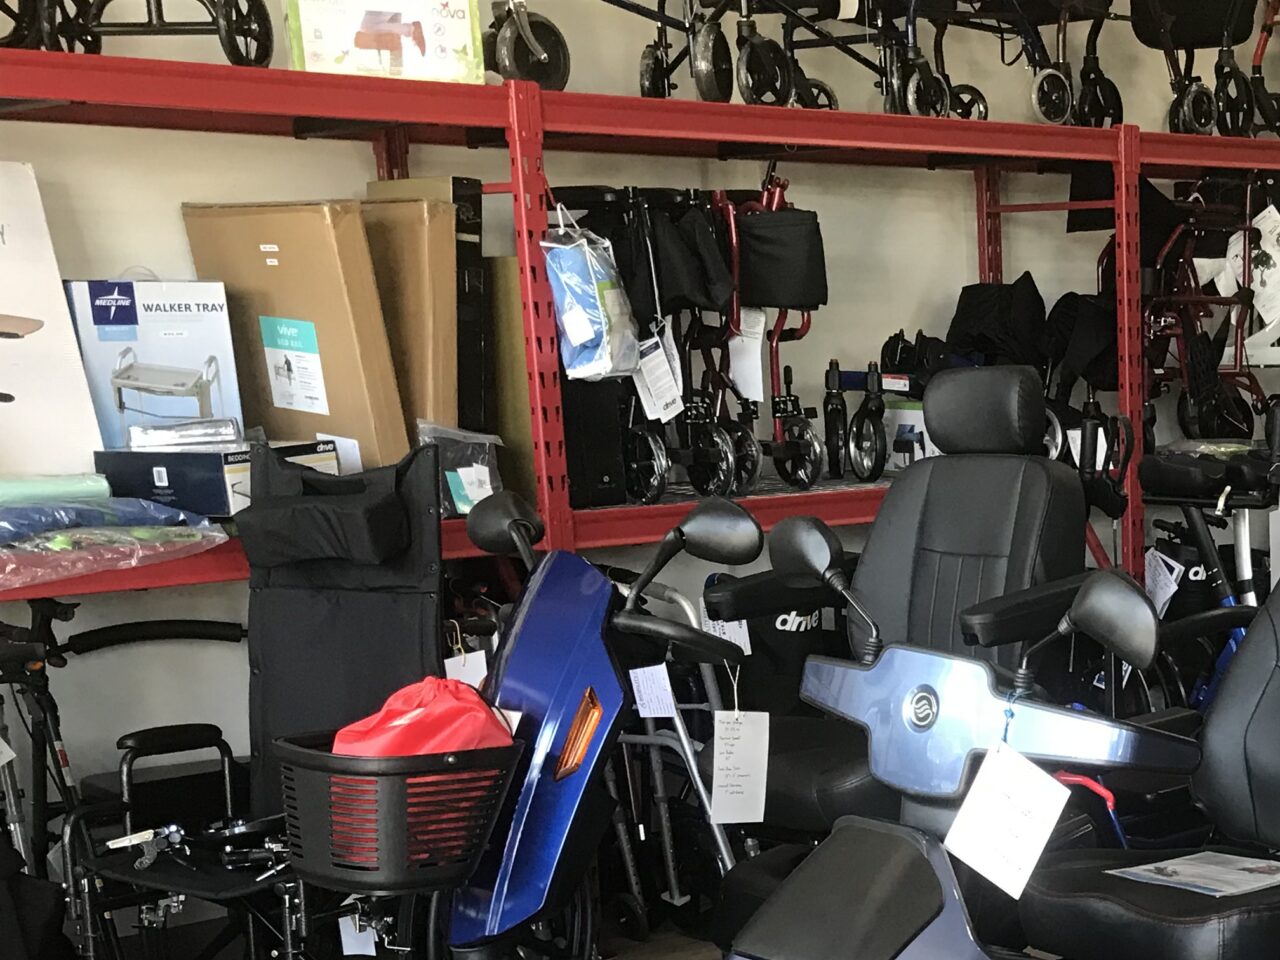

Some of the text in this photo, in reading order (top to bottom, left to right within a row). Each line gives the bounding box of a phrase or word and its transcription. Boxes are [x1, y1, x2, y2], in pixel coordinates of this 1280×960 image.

[94, 298, 132, 307] MEDLINE
[142, 302, 226, 314] WALKER TRAY
[662, 397, 677, 411] drive
[316, 443, 335, 452] drive
